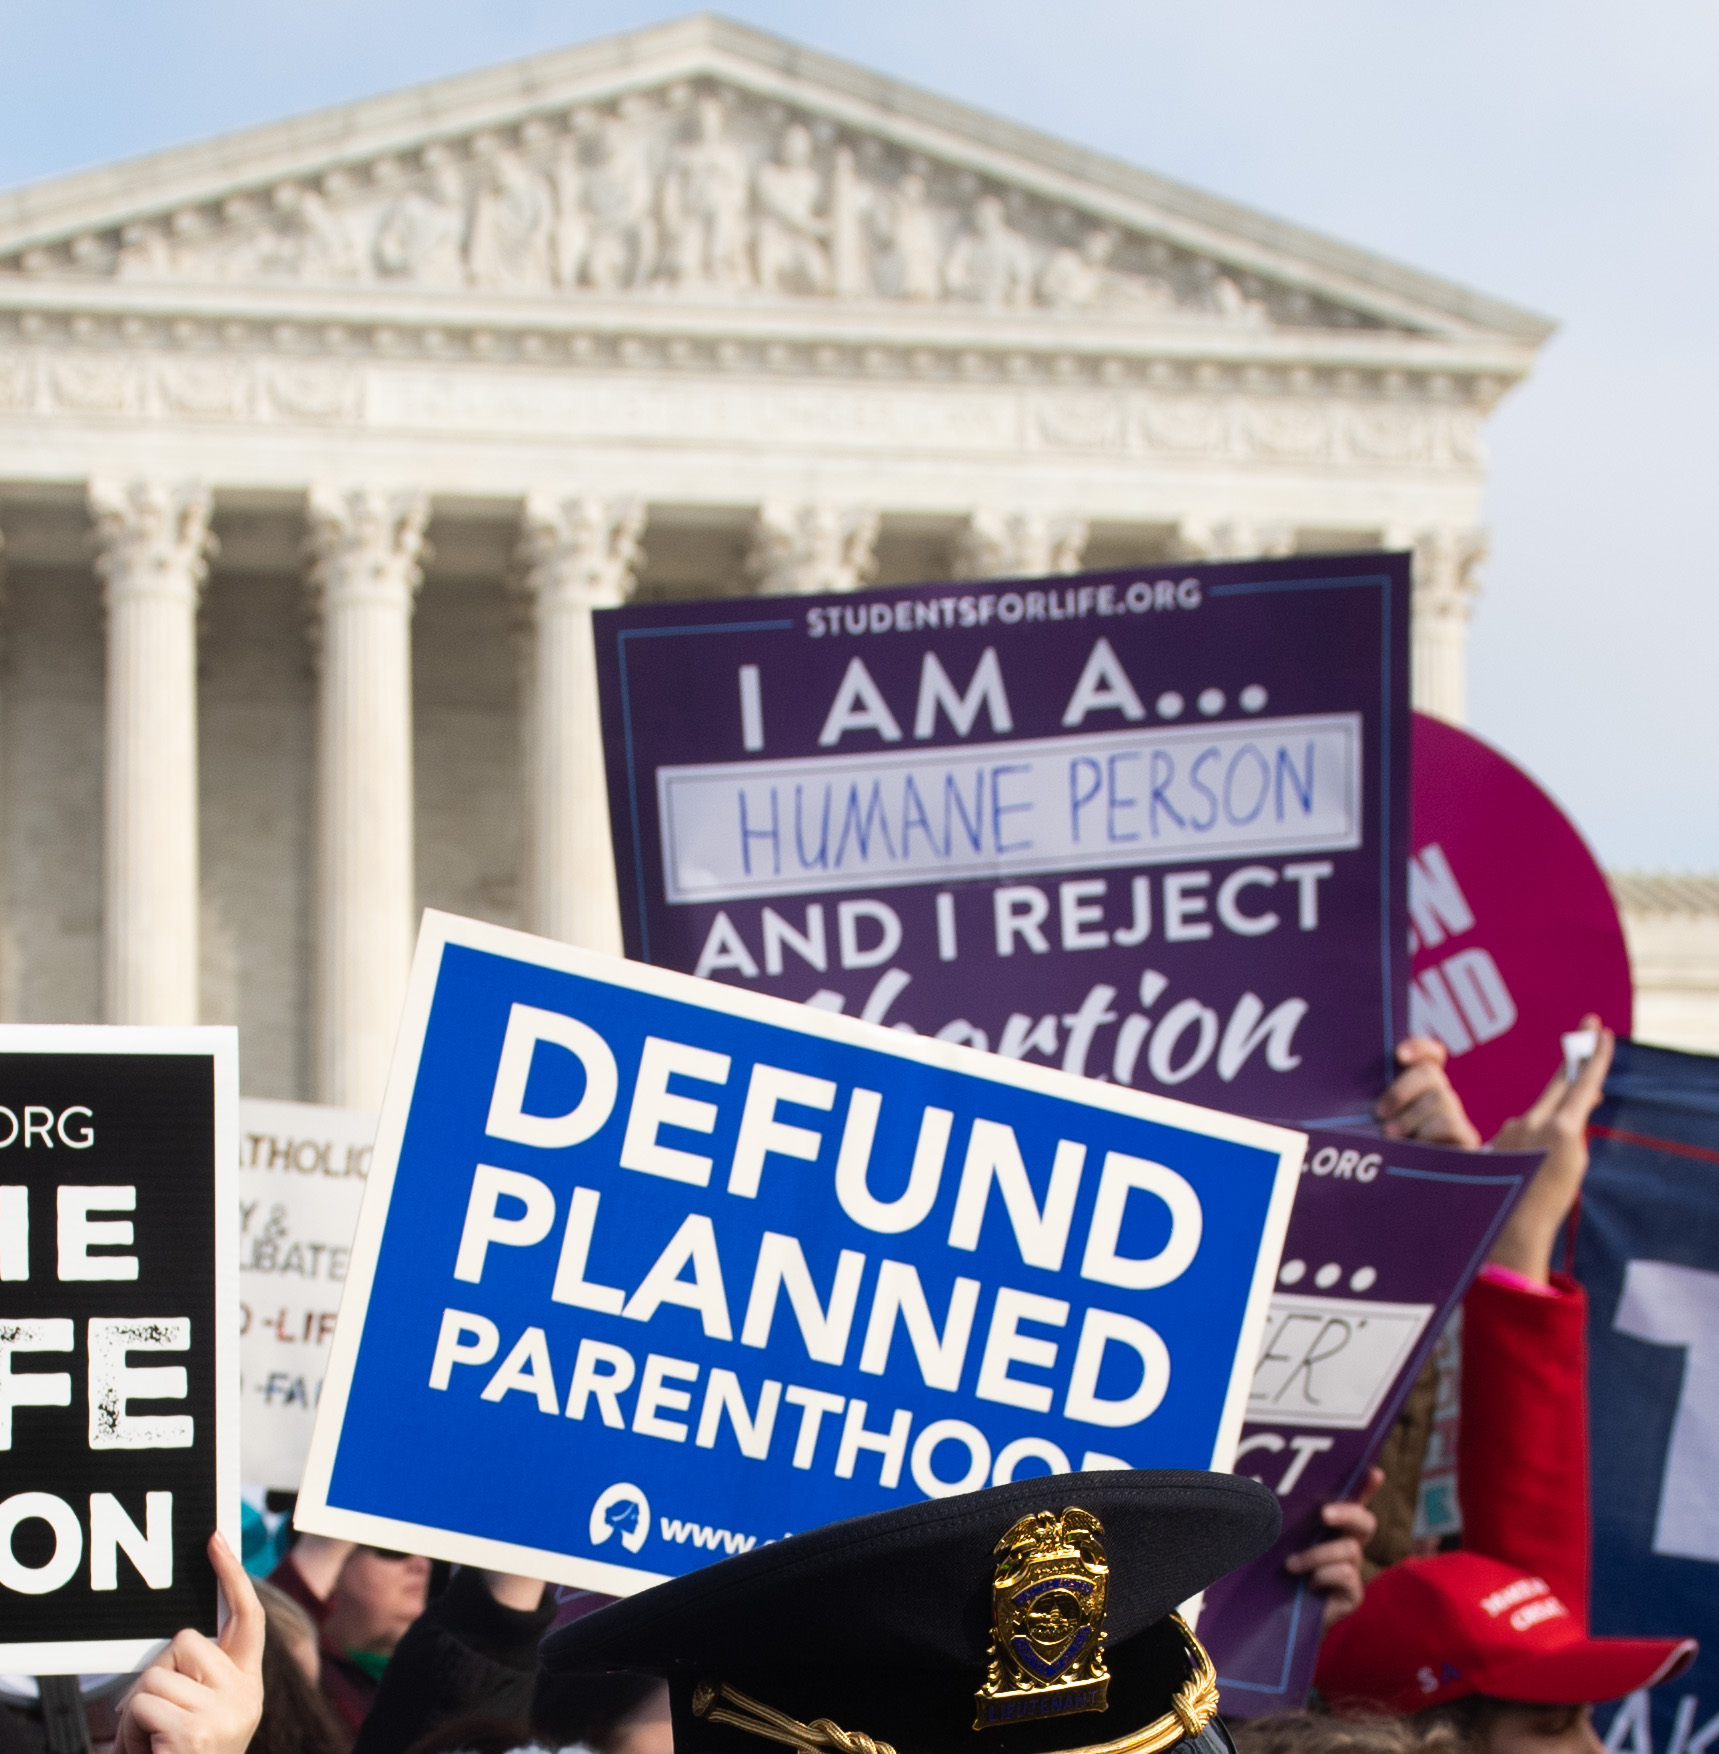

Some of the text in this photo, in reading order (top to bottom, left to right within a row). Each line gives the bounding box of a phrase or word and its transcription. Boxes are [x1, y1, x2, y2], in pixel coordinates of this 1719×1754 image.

[805, 578, 1203, 639] STUDENTSFORLIFE.ORG
[737, 636, 1269, 752] I AM A...
[737, 738, 1317, 877] HUMANE PERSON
[693, 861, 1334, 980] AND I REJECT
[239, 1132, 373, 1182] THOLIC
[484, 1001, 1205, 1293] DEFUND
[453, 1162, 1171, 1430] PLANNED
[988, 1690, 1097, 1722] LIEUTENANT
